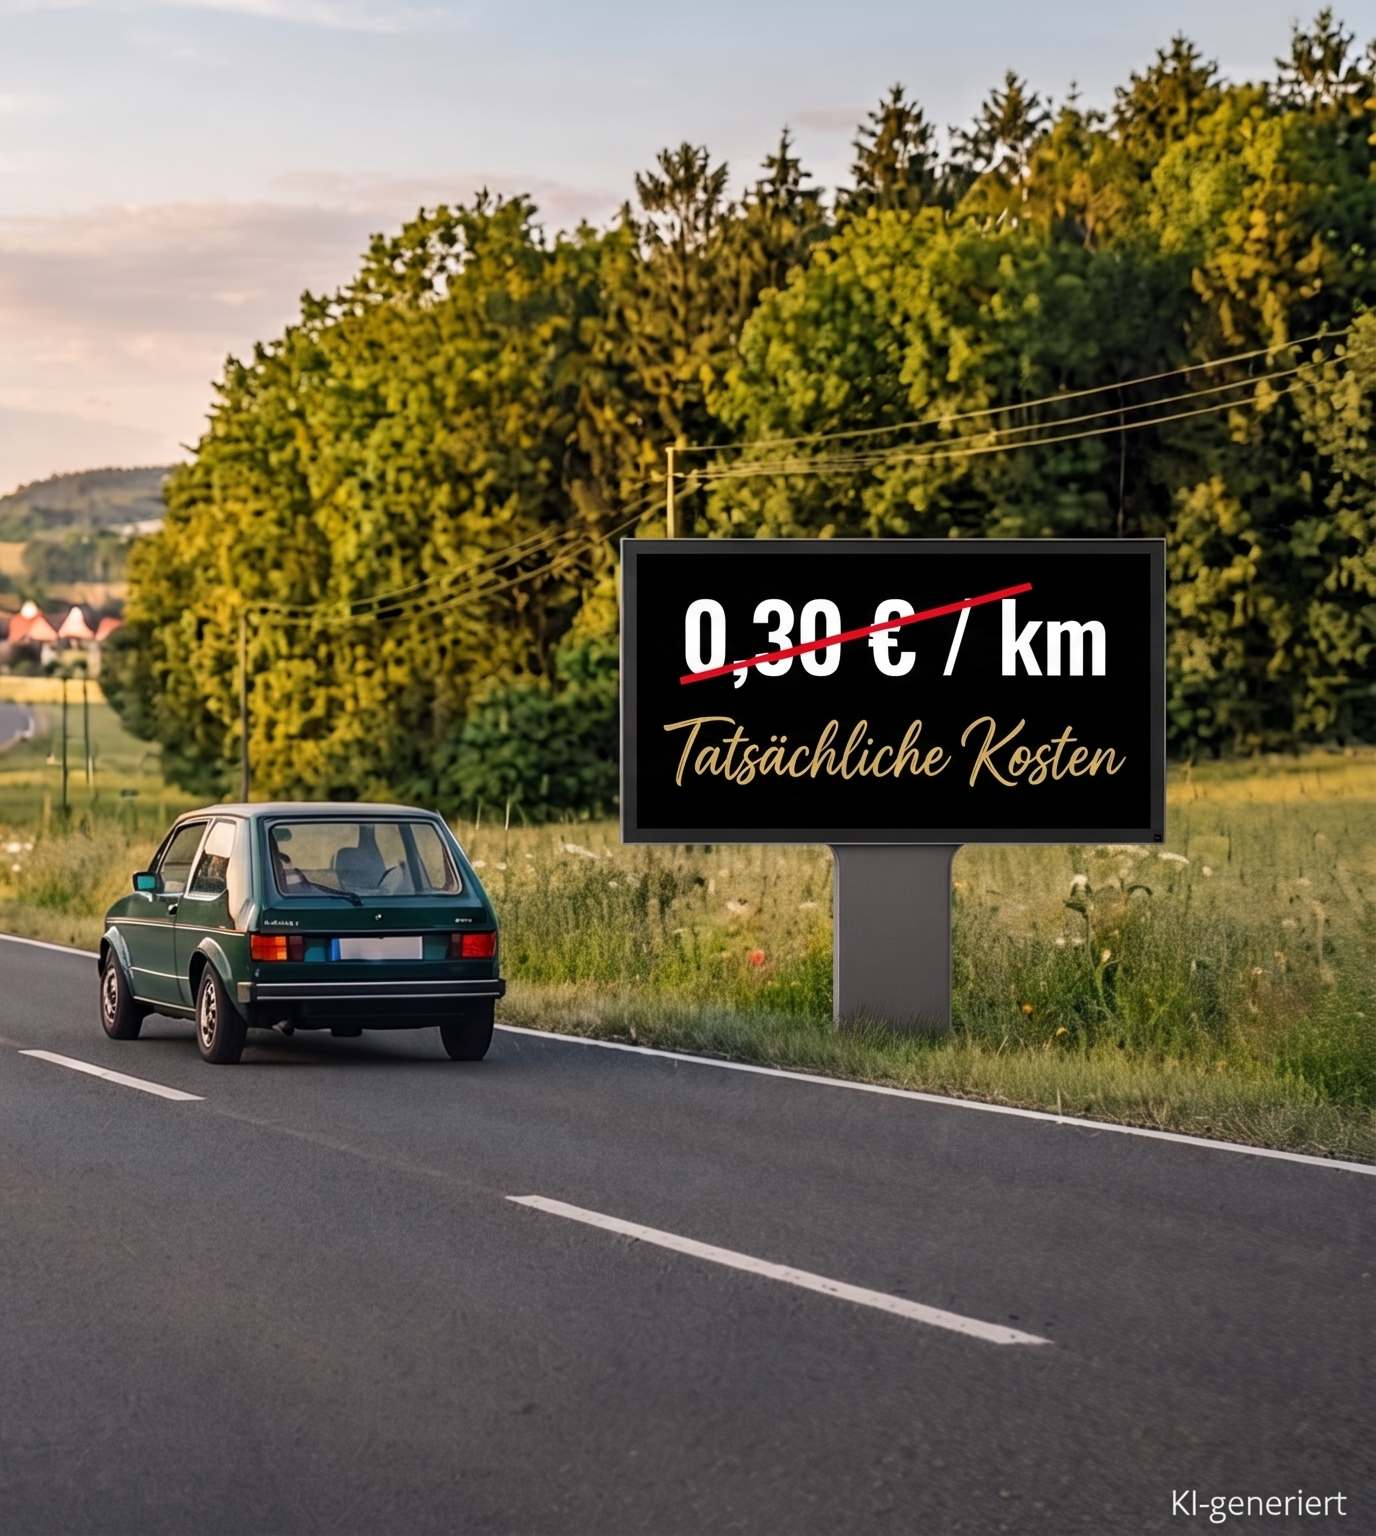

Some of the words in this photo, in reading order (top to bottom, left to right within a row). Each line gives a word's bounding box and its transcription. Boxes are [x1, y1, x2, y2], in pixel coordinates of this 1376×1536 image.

[684, 598, 842, 689] 0,30
[867, 598, 917, 677] €
[942, 597, 972, 677] /
[1001, 598, 1106, 677] km
[663, 715, 952, 787] Tatsächliche
[960, 715, 1127, 788] Kosten
